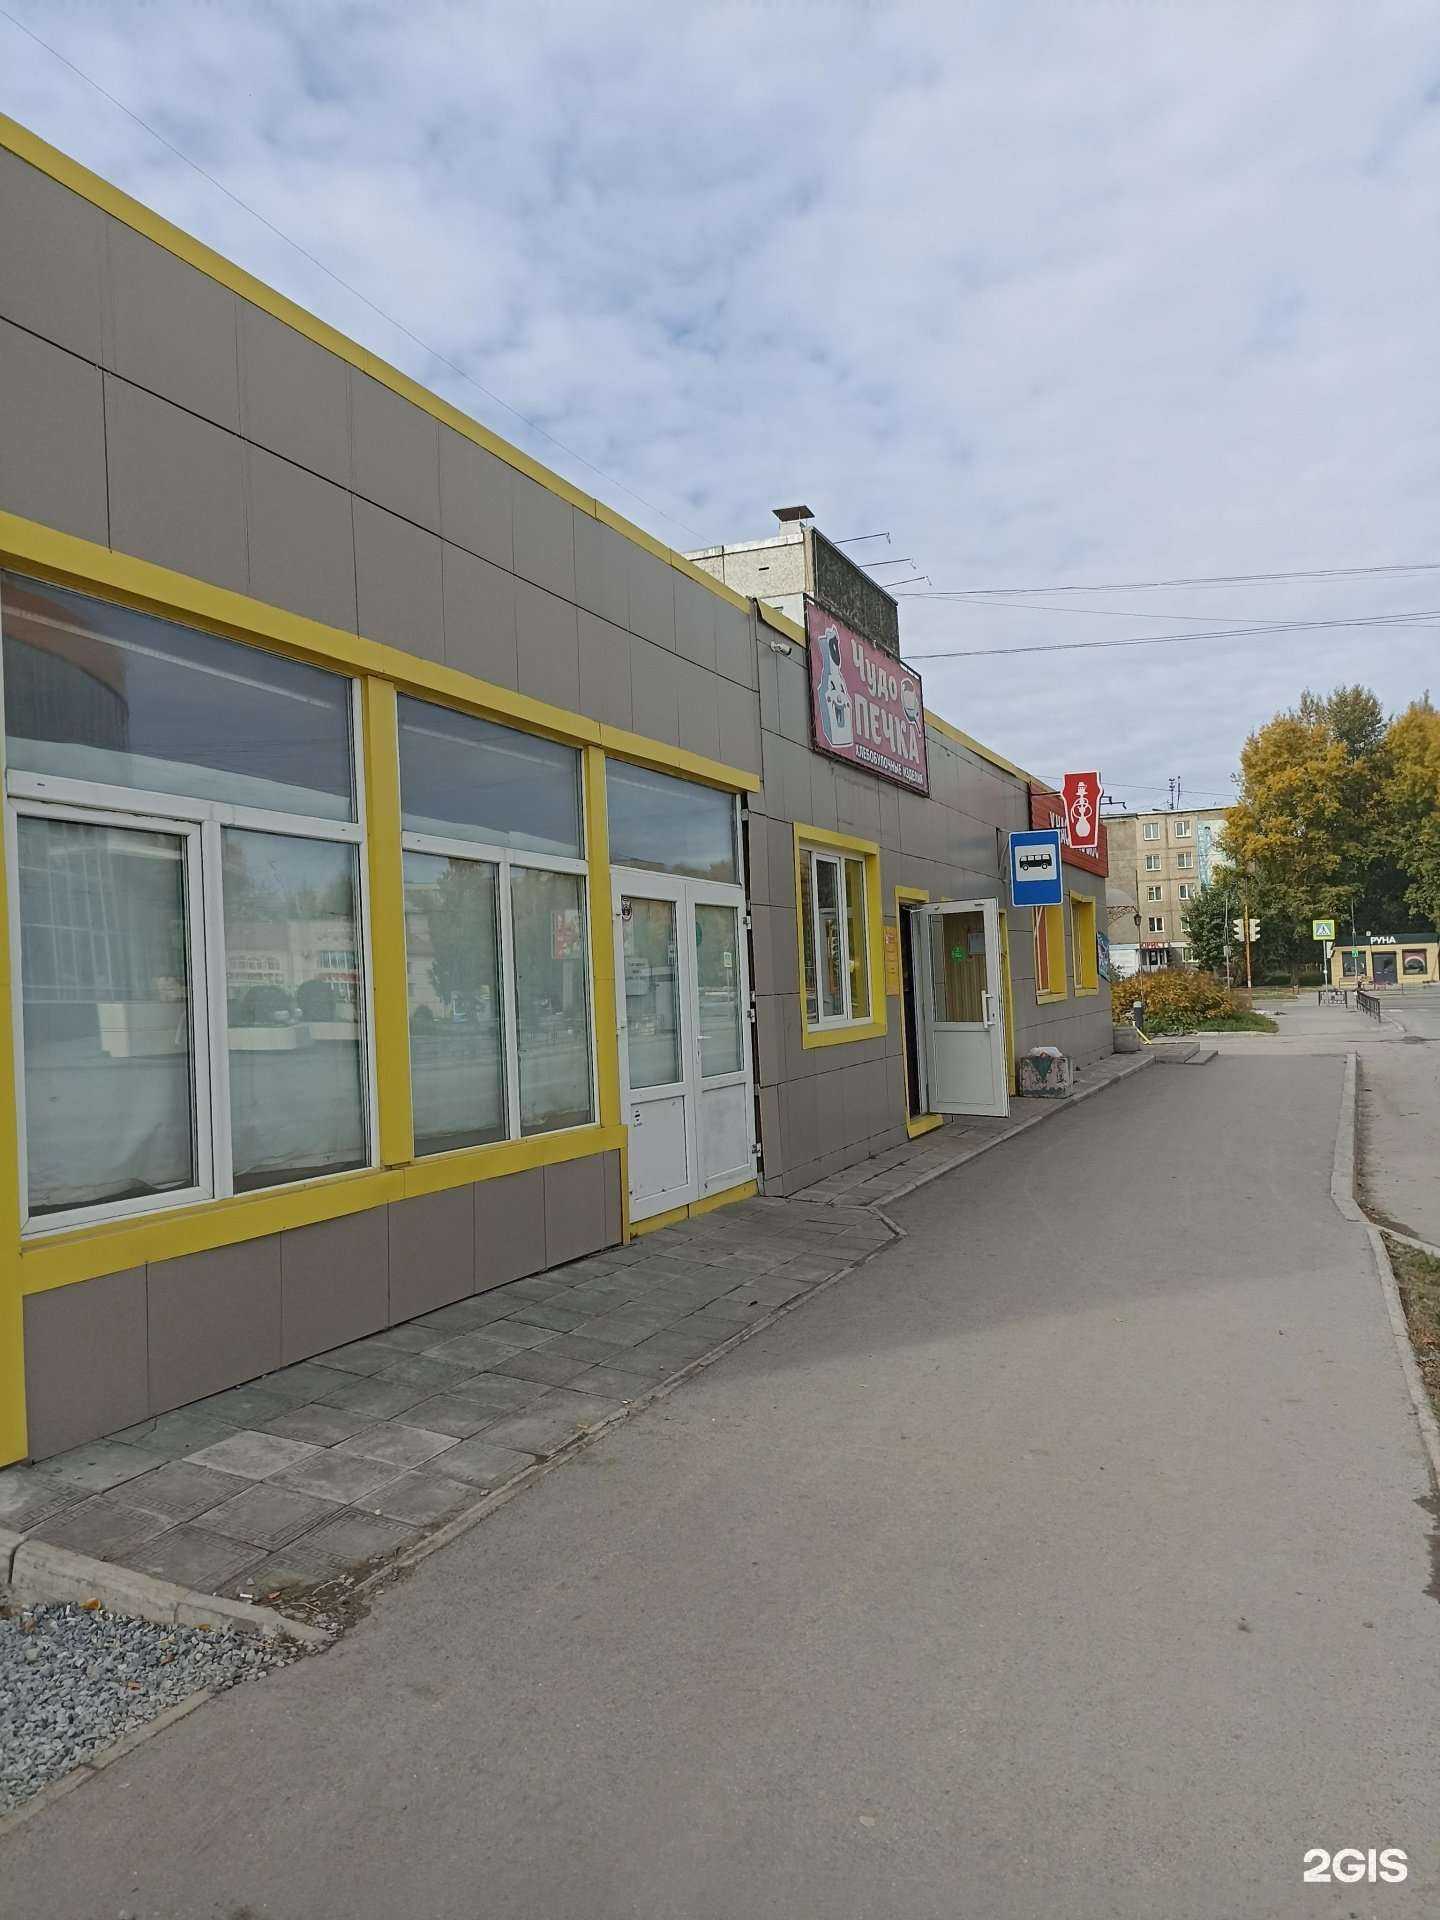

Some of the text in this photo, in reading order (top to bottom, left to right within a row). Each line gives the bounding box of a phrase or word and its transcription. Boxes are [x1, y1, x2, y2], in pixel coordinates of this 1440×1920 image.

[851, 638, 898, 702] ЧУДО
[855, 693, 920, 764] ПЕЧКА
[855, 744, 924, 785] ХЛЕБОБУЛОЧНЫЕ ИЗДЕЛИЯ
[1370, 936, 1396, 945] РУНА
